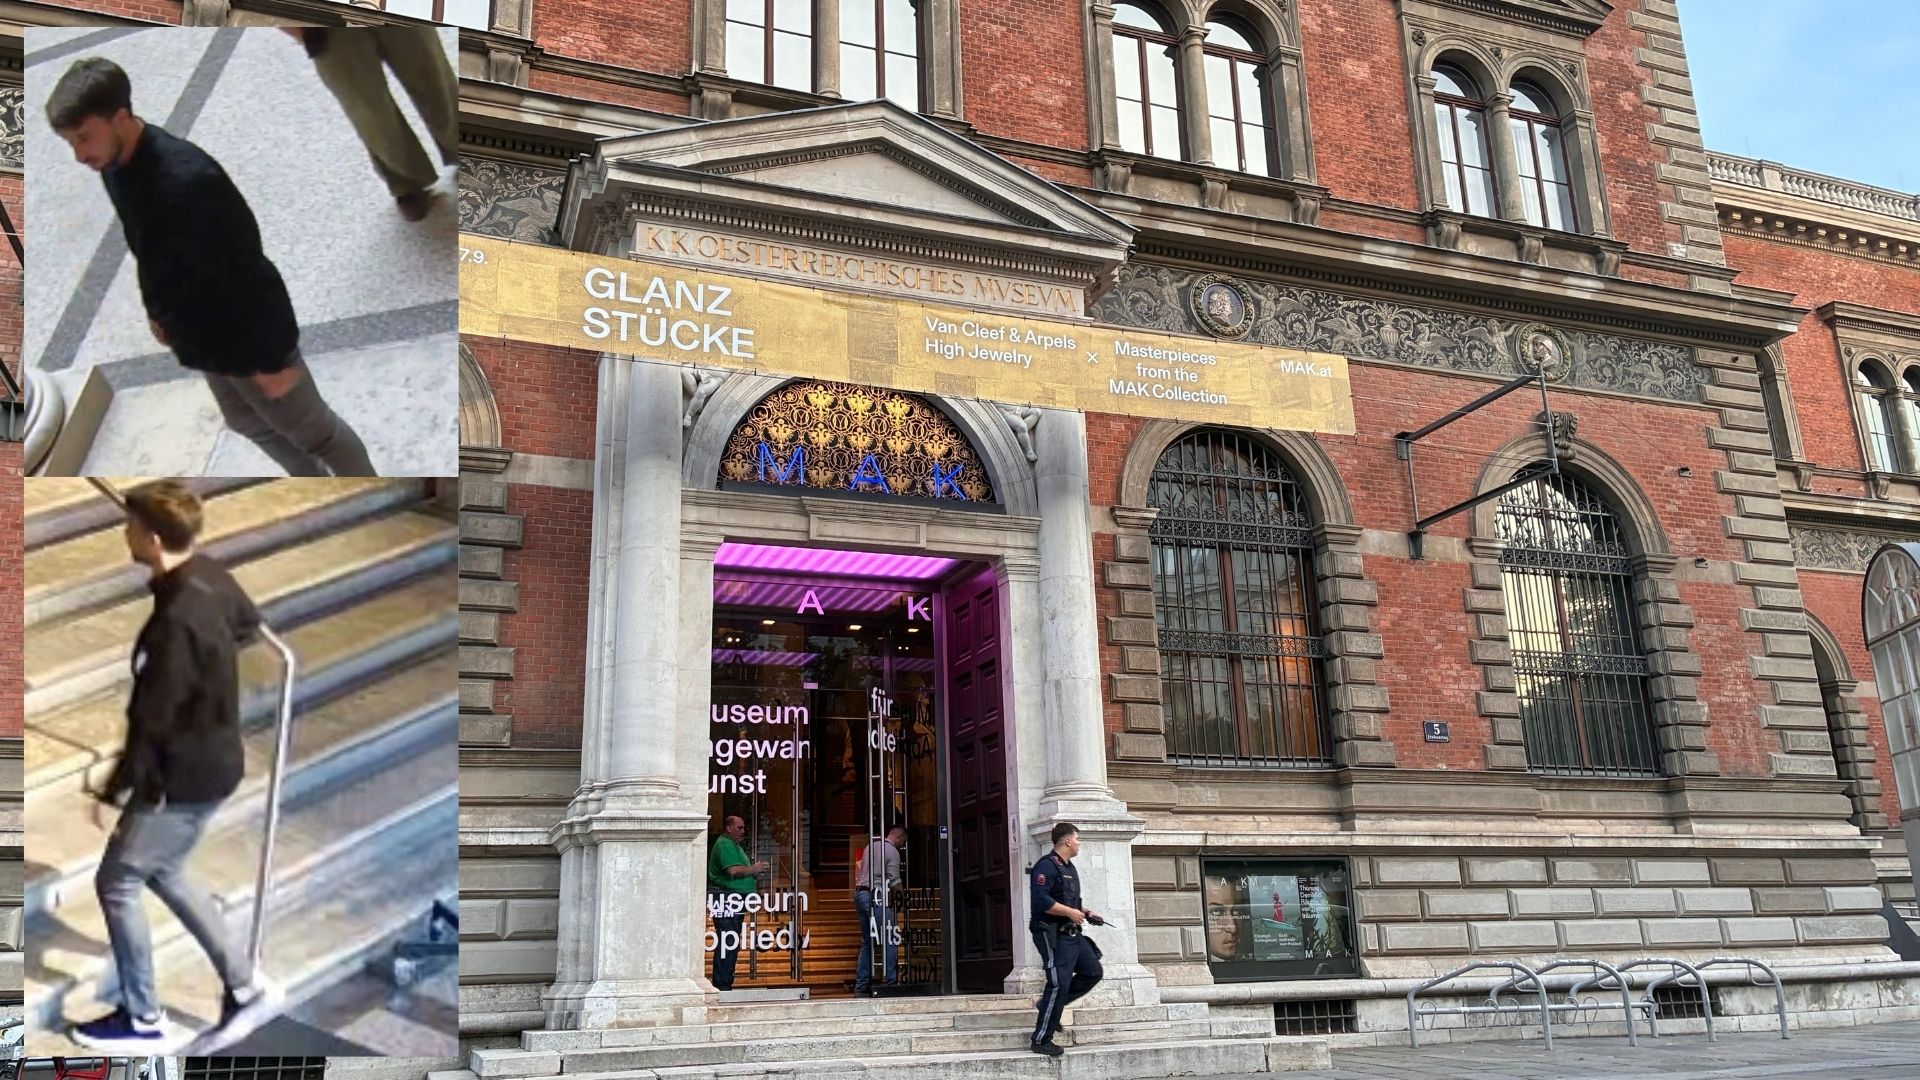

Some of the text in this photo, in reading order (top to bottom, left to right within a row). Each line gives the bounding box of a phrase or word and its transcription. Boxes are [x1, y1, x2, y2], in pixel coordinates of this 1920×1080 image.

[697, 235, 965, 296] OESTERREICHISCHES
[974, 276, 1078, 312] MVSEVM
[584, 267, 732, 317] GLANZ
[582, 307, 755, 359] STÜCKE
[926, 316, 1076, 350] Van Cleef & Arpels
[925, 338, 1032, 369] High Jewelry
[1114, 340, 1217, 366] Masterpieces
[1280, 359, 1334, 378] MAK.at
[1136, 363, 1199, 383] from the
[1109, 379, 1228, 405] MAK Collection
[711, 704, 809, 725] useum
[871, 686, 894, 717] für
[868, 721, 896, 753] dte
[1433, 723, 1441, 735] 5
